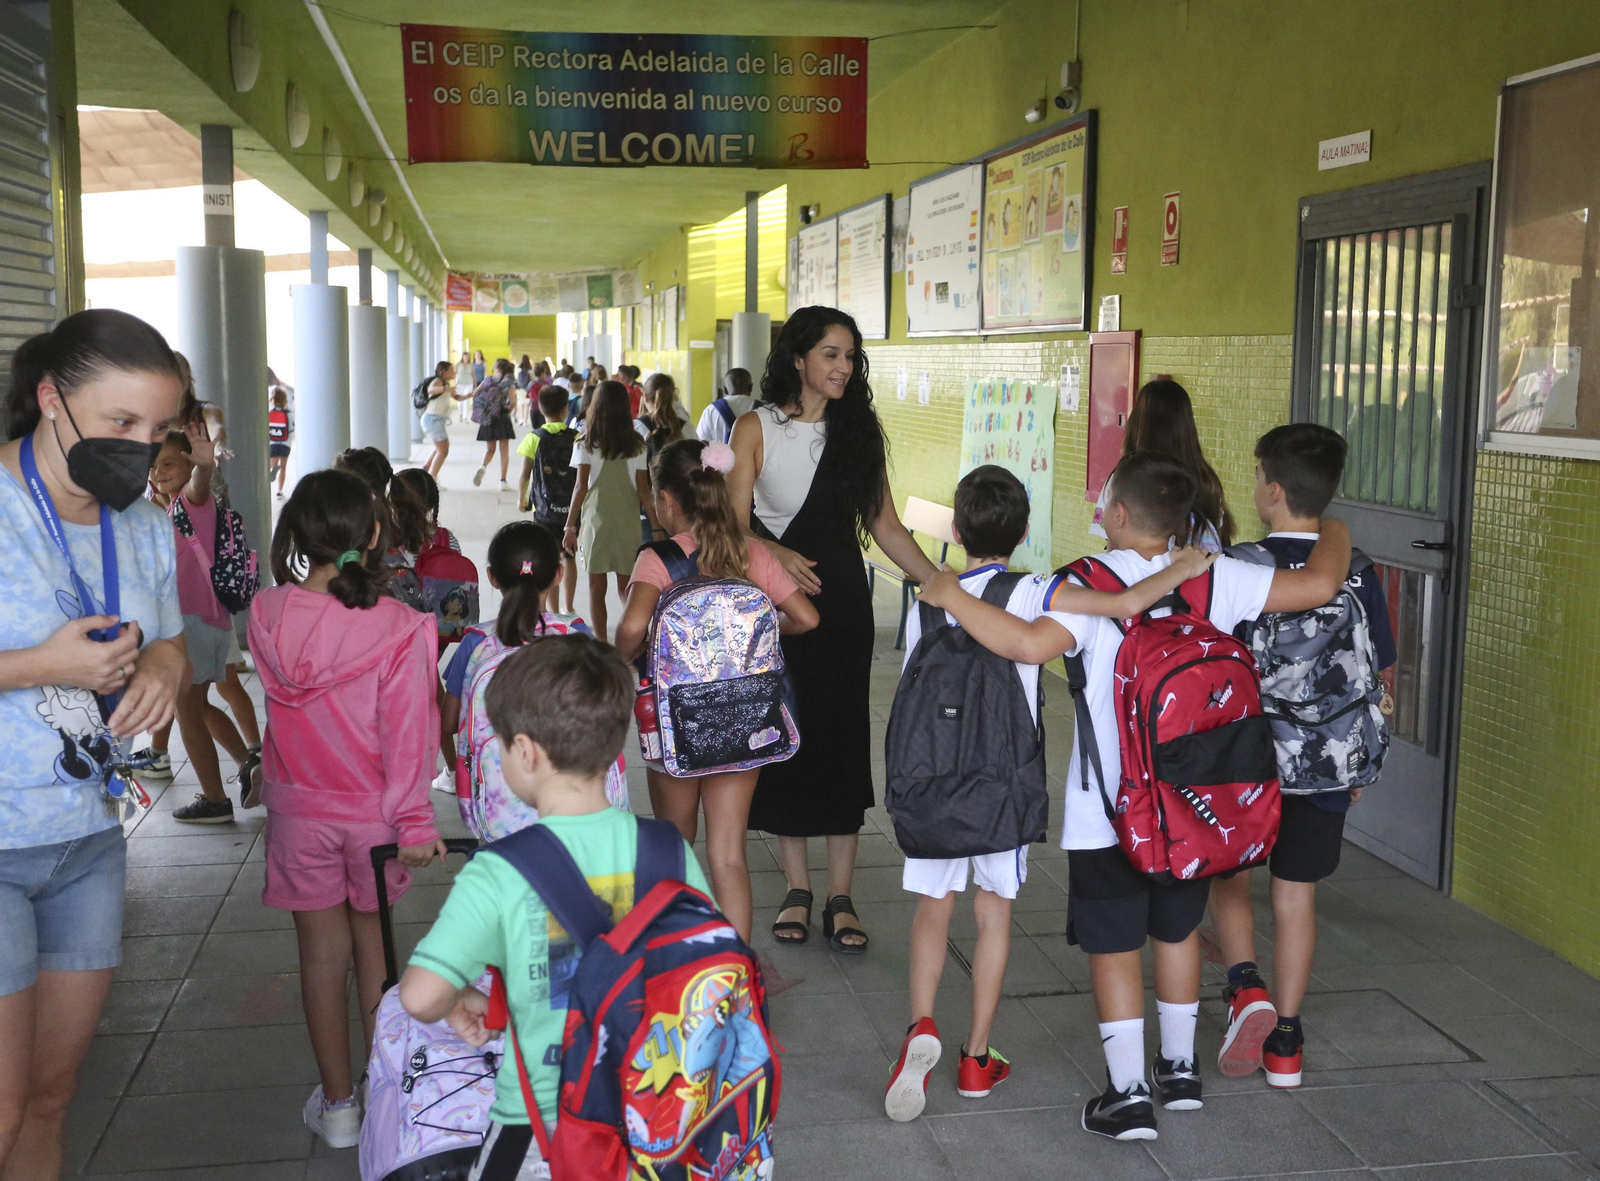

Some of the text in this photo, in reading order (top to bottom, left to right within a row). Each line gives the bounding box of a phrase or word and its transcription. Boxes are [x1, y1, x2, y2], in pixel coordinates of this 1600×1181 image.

[411, 41, 860, 77] El CEIP Rectora Adelaida de la Calle
[433, 83, 842, 114] os da la bienvenida al nuevo curso
[528, 129, 756, 164] WELCOME!
[1321, 141, 1369, 160] AULA MATINAL
[203, 193, 231, 206] INIST
[1180, 788, 1218, 826] JORDAN
[1249, 841, 1265, 861] MAN
[1181, 857, 1200, 879] JUMP
